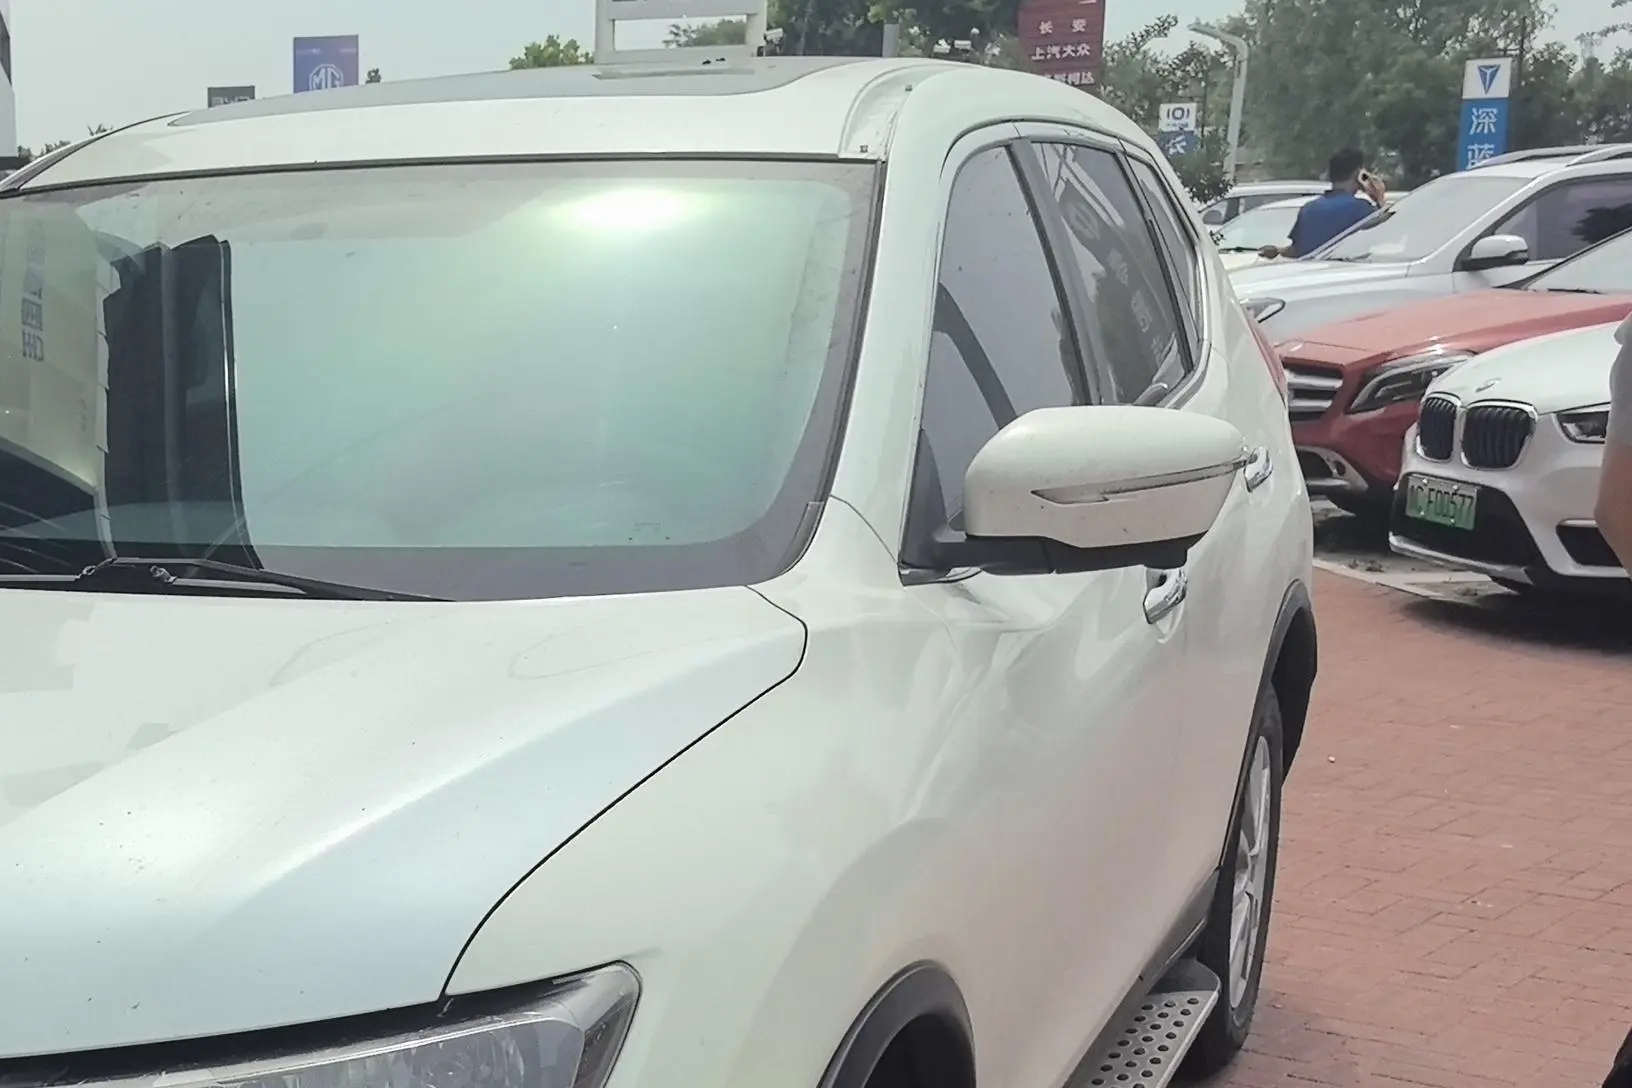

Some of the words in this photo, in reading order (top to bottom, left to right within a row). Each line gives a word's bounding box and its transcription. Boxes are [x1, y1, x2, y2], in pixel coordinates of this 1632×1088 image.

[1039, 18, 1087, 33] 长安
[1031, 43, 1090, 61] 上汽大众
